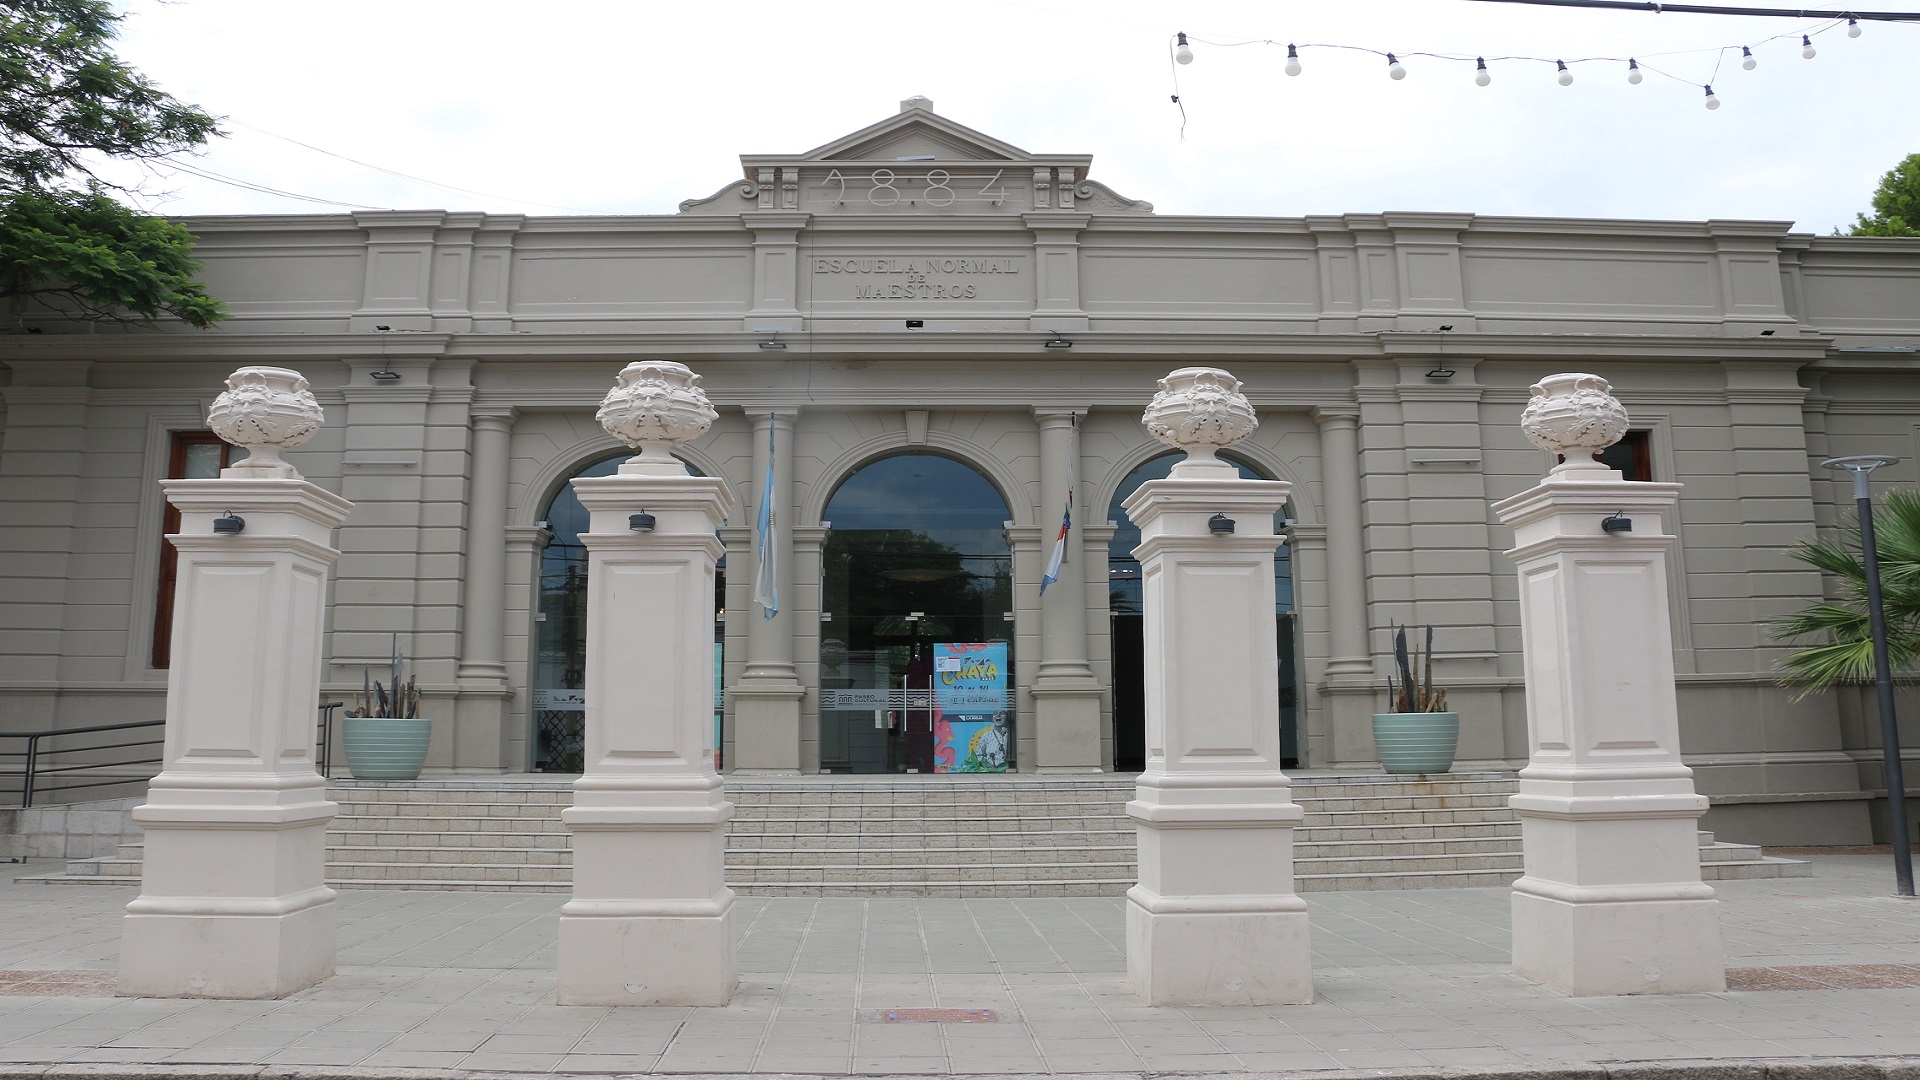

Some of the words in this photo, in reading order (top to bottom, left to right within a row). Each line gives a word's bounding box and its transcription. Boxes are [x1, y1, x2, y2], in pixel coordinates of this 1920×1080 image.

[822, 168, 1010, 207] 1884
[814, 259, 919, 274] ESCUELA
[926, 259, 1019, 274] NORMAL
[907, 274, 926, 283] DE
[855, 284, 977, 299] MAESTROS
[942, 664, 998, 686] CHAYA
